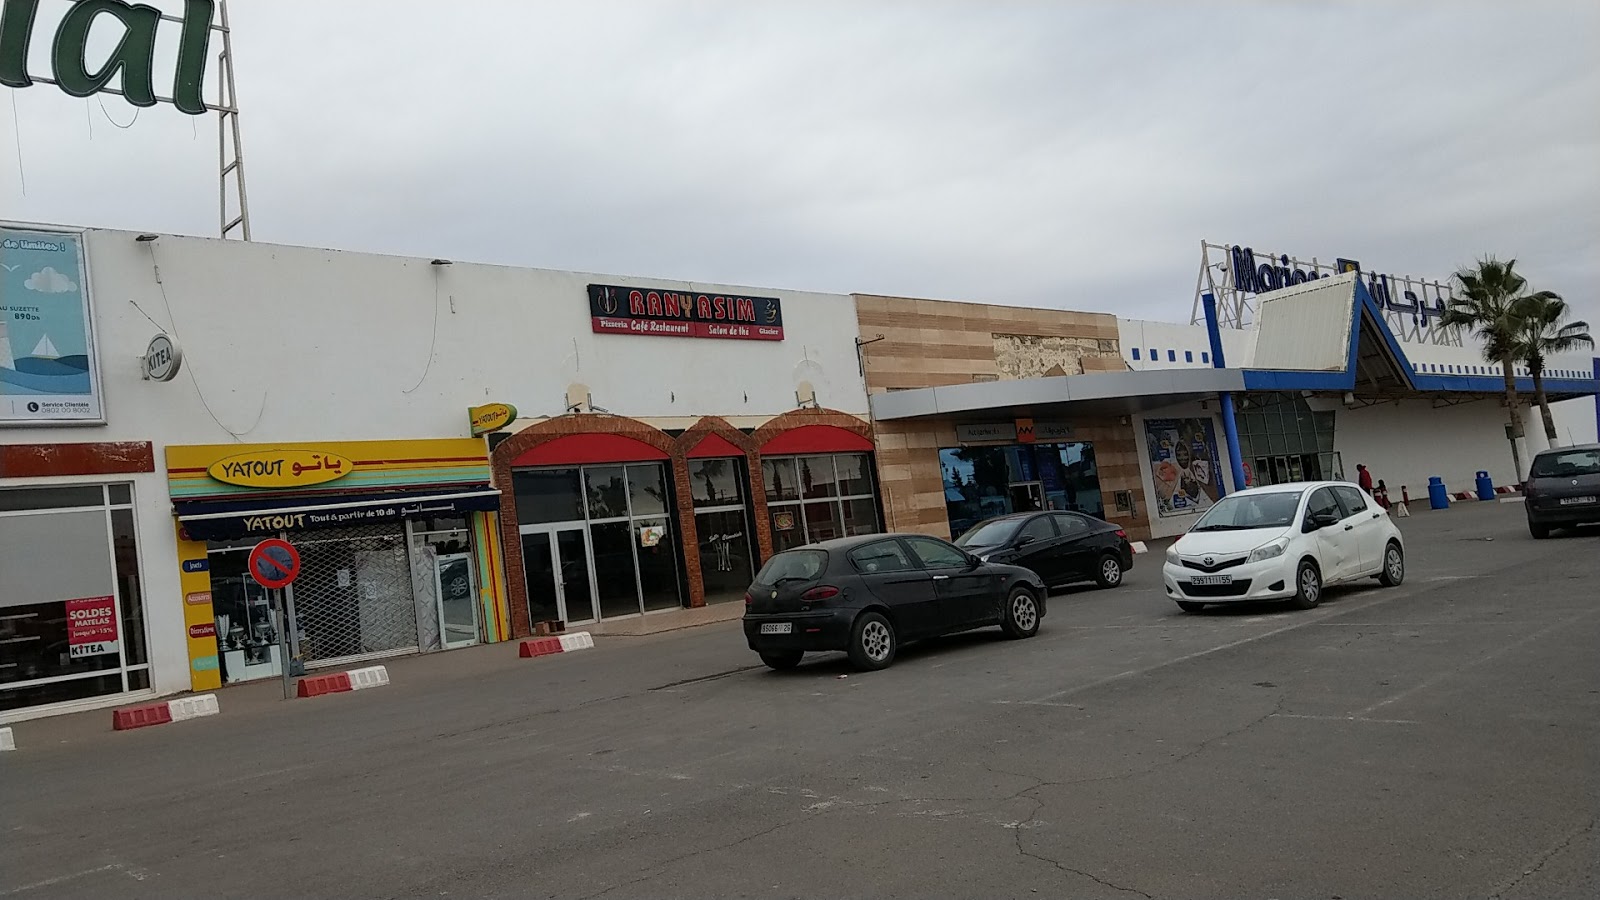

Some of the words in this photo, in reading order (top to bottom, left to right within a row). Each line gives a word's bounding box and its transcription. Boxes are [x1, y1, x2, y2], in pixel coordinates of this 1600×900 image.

[3, 239, 19, 249] de
[600, 320, 629, 328] Pizzeria
[631, 320, 648, 333] Café
[709, 324, 728, 335] Salon
[729, 326, 738, 335] de
[738, 326, 750, 336] thé
[221, 459, 285, 478] YATOUT
[243, 513, 307, 532] YATOUT
[310, 514, 330, 523] Tout
[338, 510, 365, 522] partir
[366, 509, 375, 518] de
[376, 509, 385, 517] 10
[386, 508, 396, 516] dh
[70, 607, 112, 620] SOLDES
[75, 617, 110, 627] MATELAS
